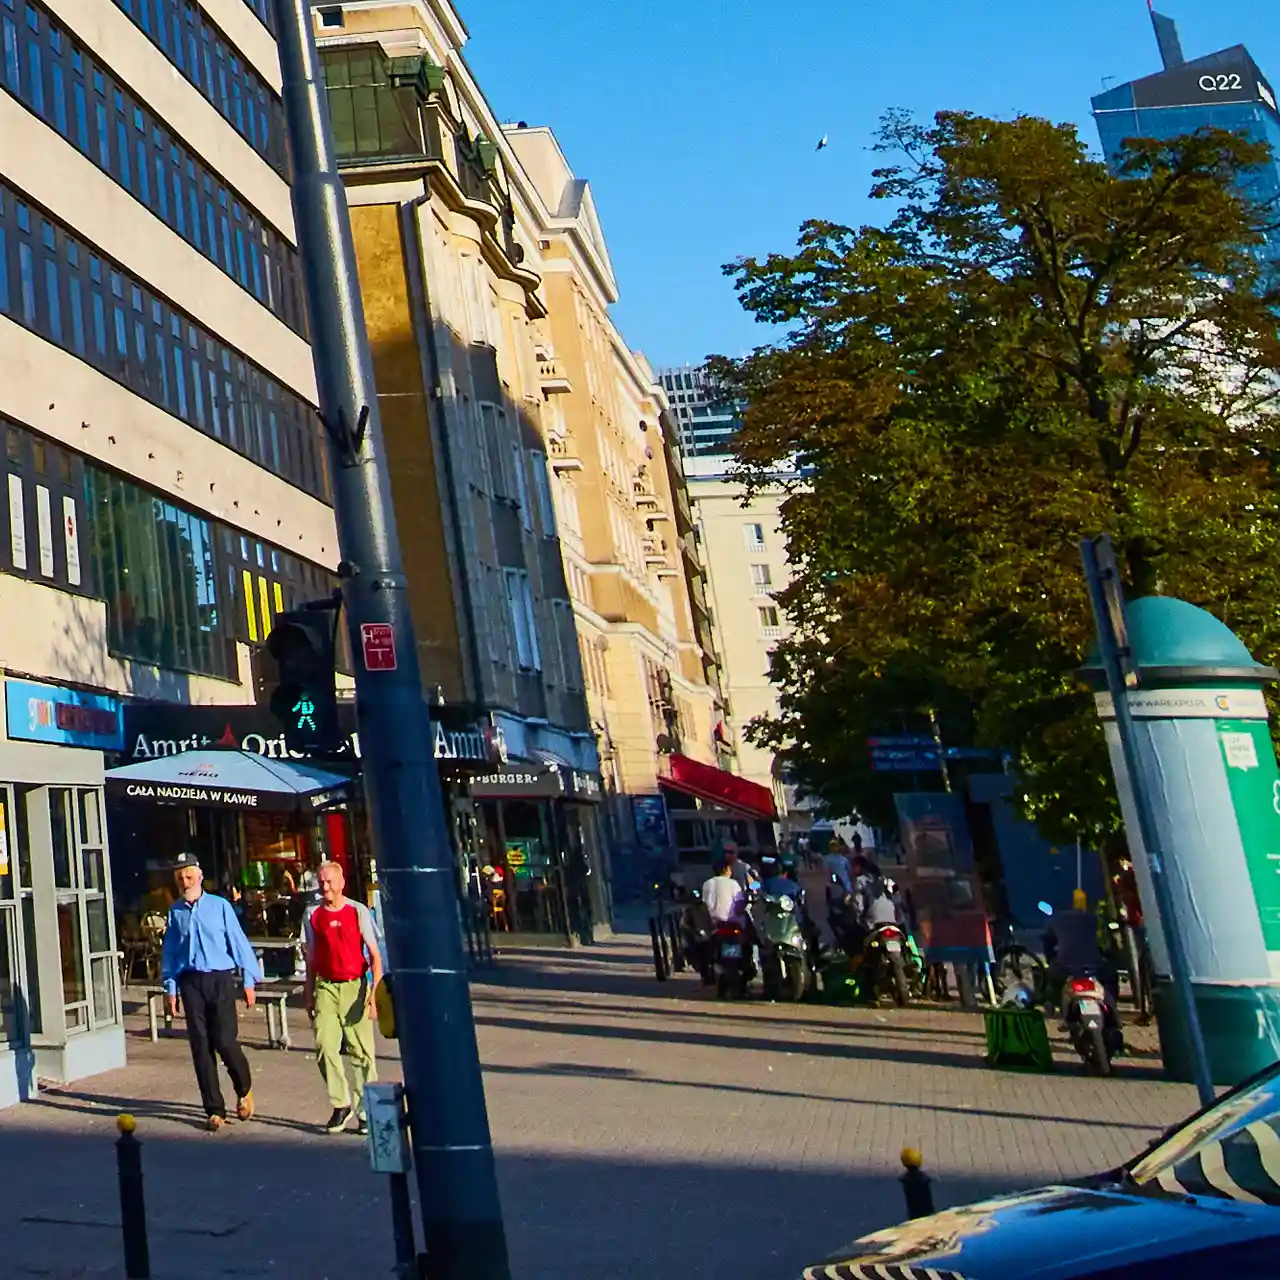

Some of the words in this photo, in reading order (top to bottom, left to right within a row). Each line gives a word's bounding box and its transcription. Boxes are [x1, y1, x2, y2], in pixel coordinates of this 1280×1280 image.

[1199, 74, 1242, 91] Q22
[126, 784, 155, 797] CAŁA
[157, 786, 208, 801] NADZIEJA
[209, 790, 222, 801] W
[223, 791, 258, 807] KAWIE
